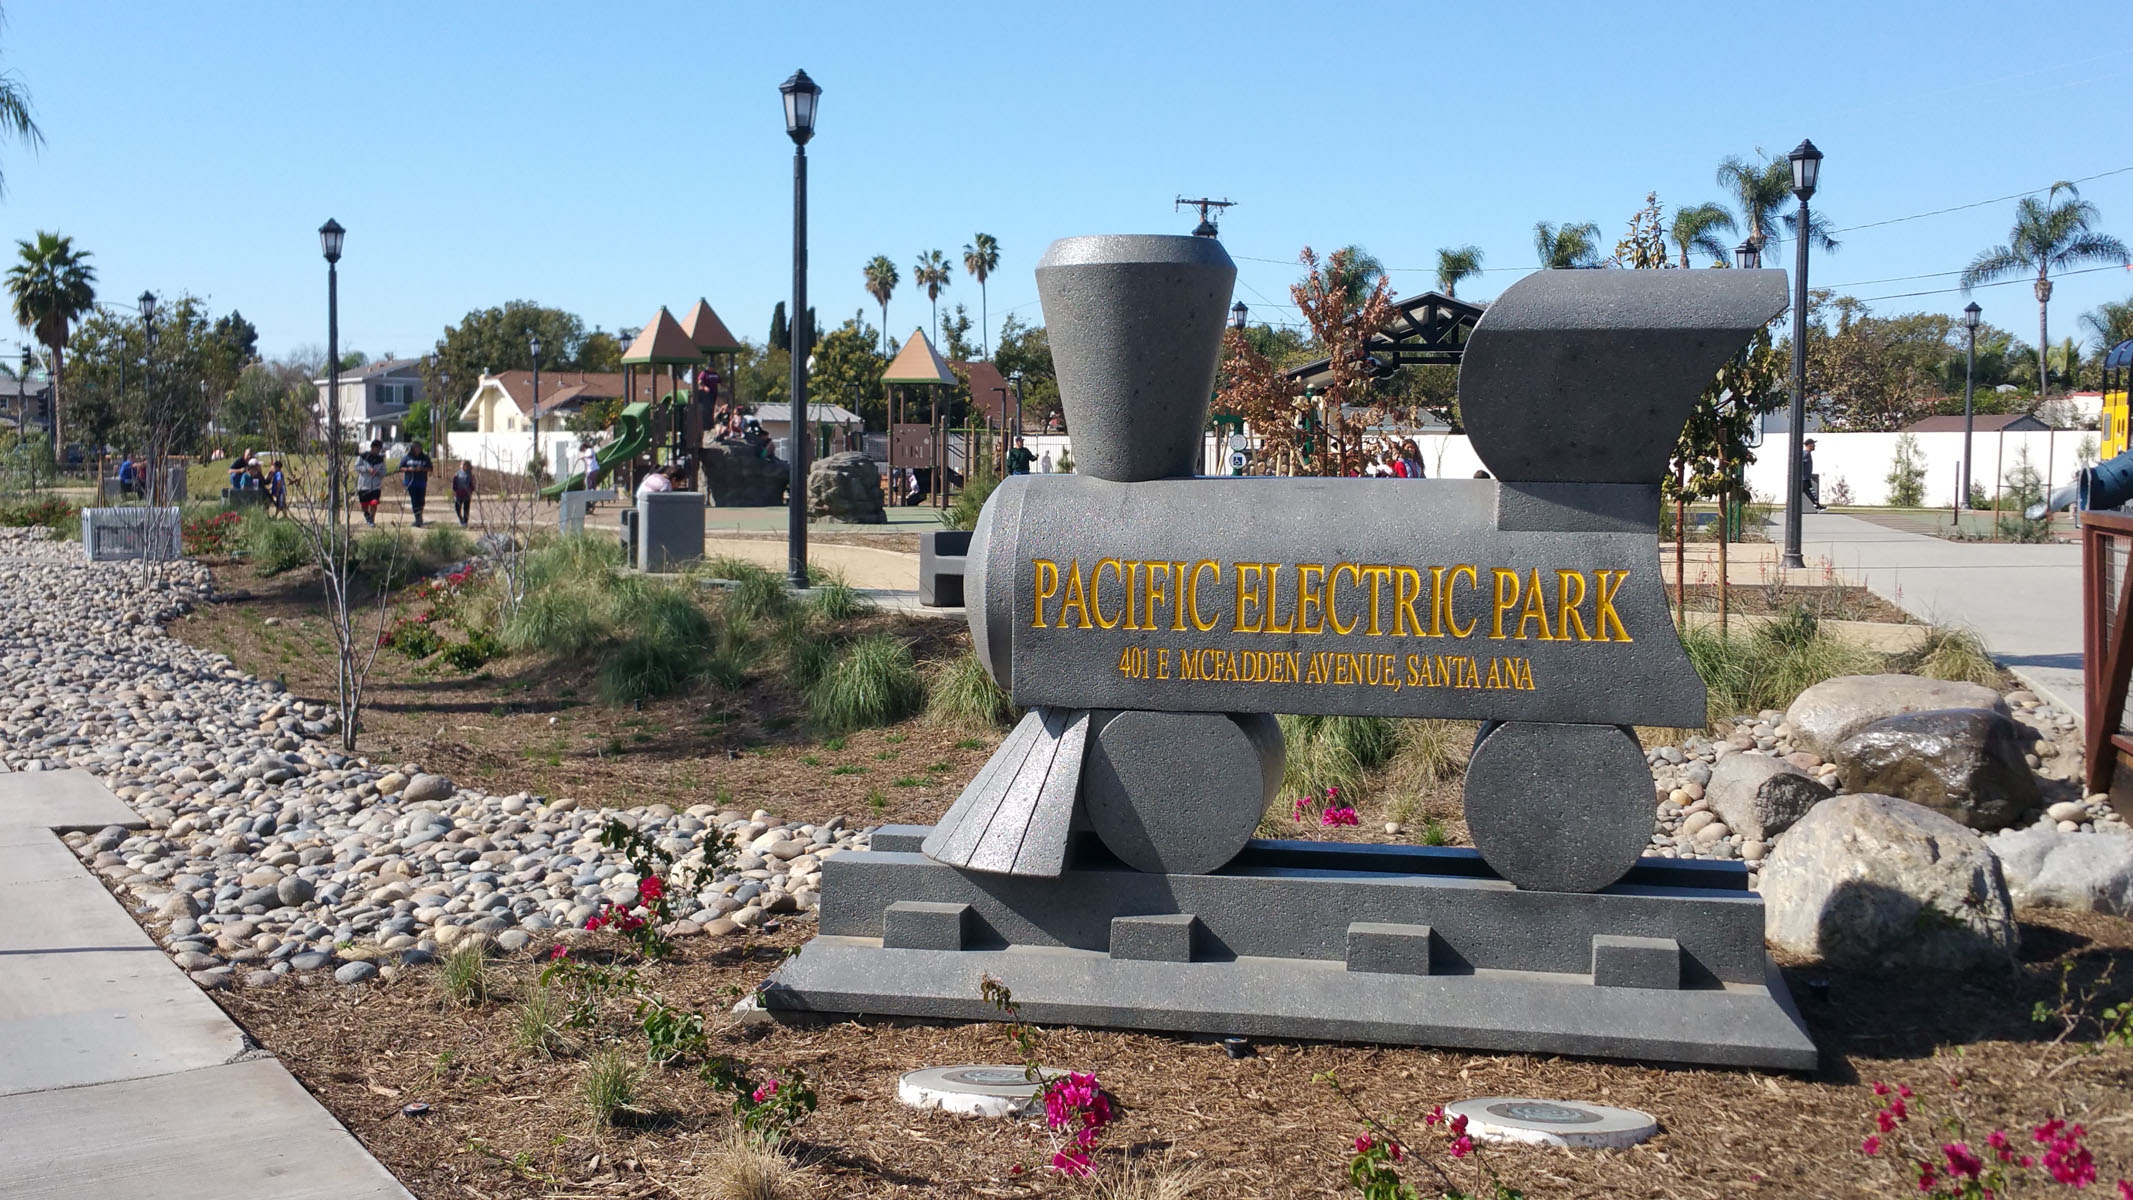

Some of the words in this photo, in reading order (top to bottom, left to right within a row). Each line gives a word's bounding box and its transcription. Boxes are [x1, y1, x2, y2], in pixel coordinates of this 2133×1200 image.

[1031, 558, 1219, 632] PACIFIC
[1232, 562, 1477, 638] ELECTRIC
[1488, 568, 1632, 643] PARK
[1117, 646, 1148, 680] 401
[1155, 648, 1169, 680] E
[1179, 648, 1299, 684] MCFADDEN
[1304, 651, 1400, 690] AVENUE,
[1406, 654, 1480, 689] SANTA
[1484, 656, 1534, 691] ANA
